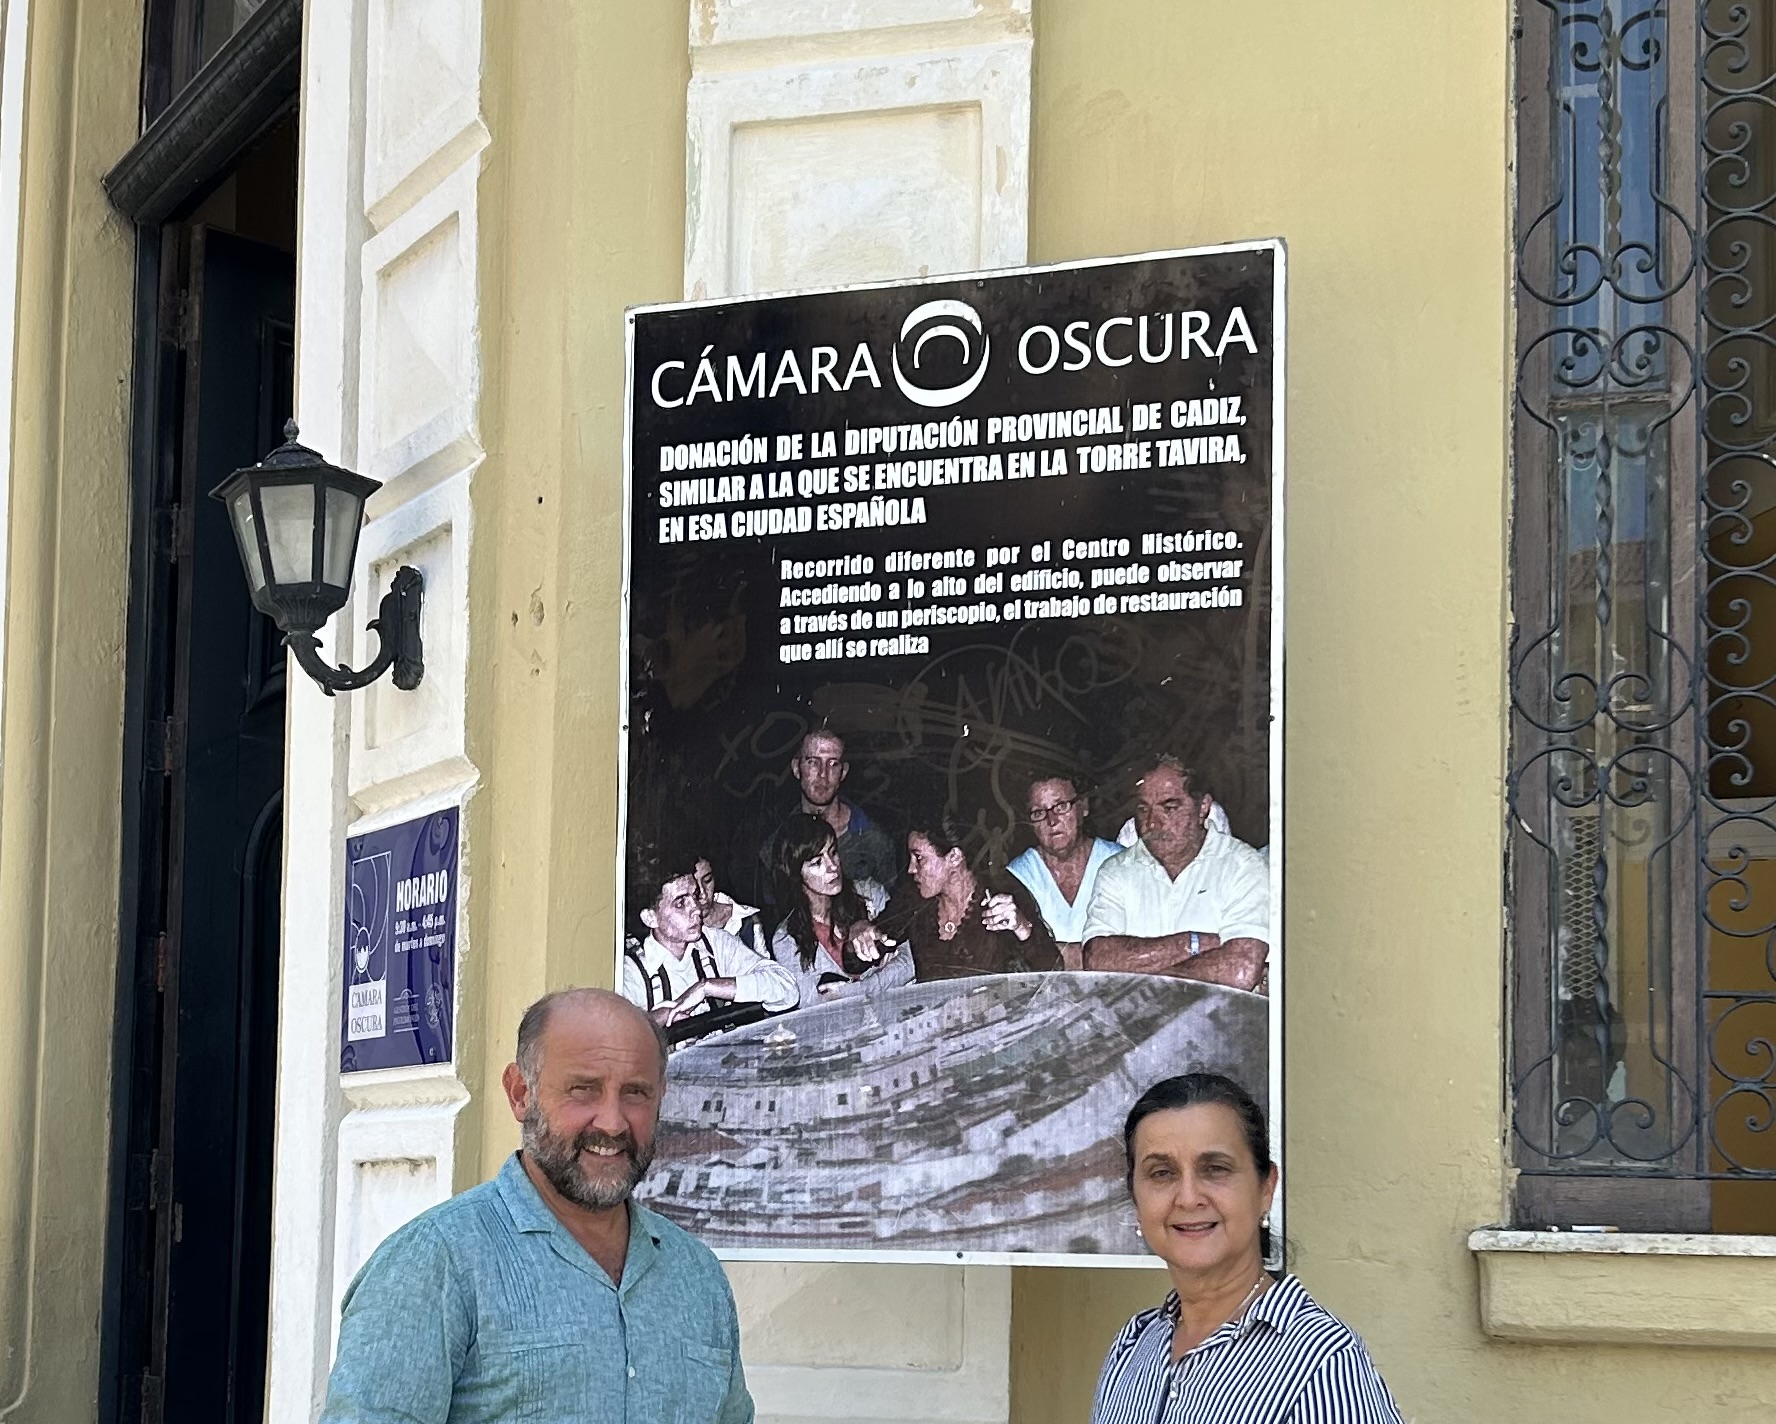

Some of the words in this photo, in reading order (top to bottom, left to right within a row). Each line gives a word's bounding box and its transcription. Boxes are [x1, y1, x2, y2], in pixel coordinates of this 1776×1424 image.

[651, 344, 882, 408] CÁMARA
[1018, 306, 1258, 375] OSCURA
[660, 433, 768, 472] DONACIÓN
[776, 434, 803, 462] DE
[810, 431, 837, 459] LA
[845, 416, 979, 456] DIPUTACIÓN
[987, 406, 1124, 444] PROVINCIAL
[1132, 403, 1162, 432] DE
[1170, 396, 1247, 427] CADIZ,
[659, 475, 746, 508] SIMILAR
[749, 474, 765, 500] A
[768, 471, 794, 498] LA
[797, 467, 840, 498] QUE
[844, 465, 870, 493] SE
[874, 454, 1004, 490] ENCUENTRA
[1007, 450, 1036, 480] EN
[1040, 448, 1068, 477] LA
[1076, 442, 1152, 474] TORRE
[1156, 434, 1247, 468] TAVIRA,
[659, 516, 684, 544] EN
[688, 513, 728, 541] ESA
[731, 505, 812, 538] CIUDAD
[816, 495, 927, 531] ESPAÑOLA
[780, 554, 874, 580] Recorrido
[885, 548, 975, 573] diferente
[986, 546, 1021, 568] por
[1031, 540, 1051, 563] el
[1062, 537, 1130, 560] Centro
[1141, 529, 1244, 555] Histórico.
[779, 581, 882, 608] Accediendo
[888, 582, 900, 600] a
[907, 578, 925, 599] lo
[931, 576, 967, 597] alto
[973, 572, 1004, 594] del
[1010, 568, 1084, 592] edificio,
[1090, 563, 1151, 589] puede
[1157, 559, 1244, 583] observar
[779, 616, 791, 635] a
[794, 611, 848, 634] través
[851, 609, 873, 631] de
[875, 610, 899, 629] un
[901, 601, 1001, 629] periscopio,
[1003, 599, 1021, 621] el
[1024, 595, 1090, 620] trabajo
[1093, 593, 1118, 615] de
[1120, 585, 1243, 613] restauración
[779, 642, 812, 664] que
[814, 637, 843, 660] allí
[845, 638, 867, 658] se
[869, 633, 930, 657] realiza
[395, 869, 448, 914] HORARIO
[350, 1014, 383, 1035] OSCURA
